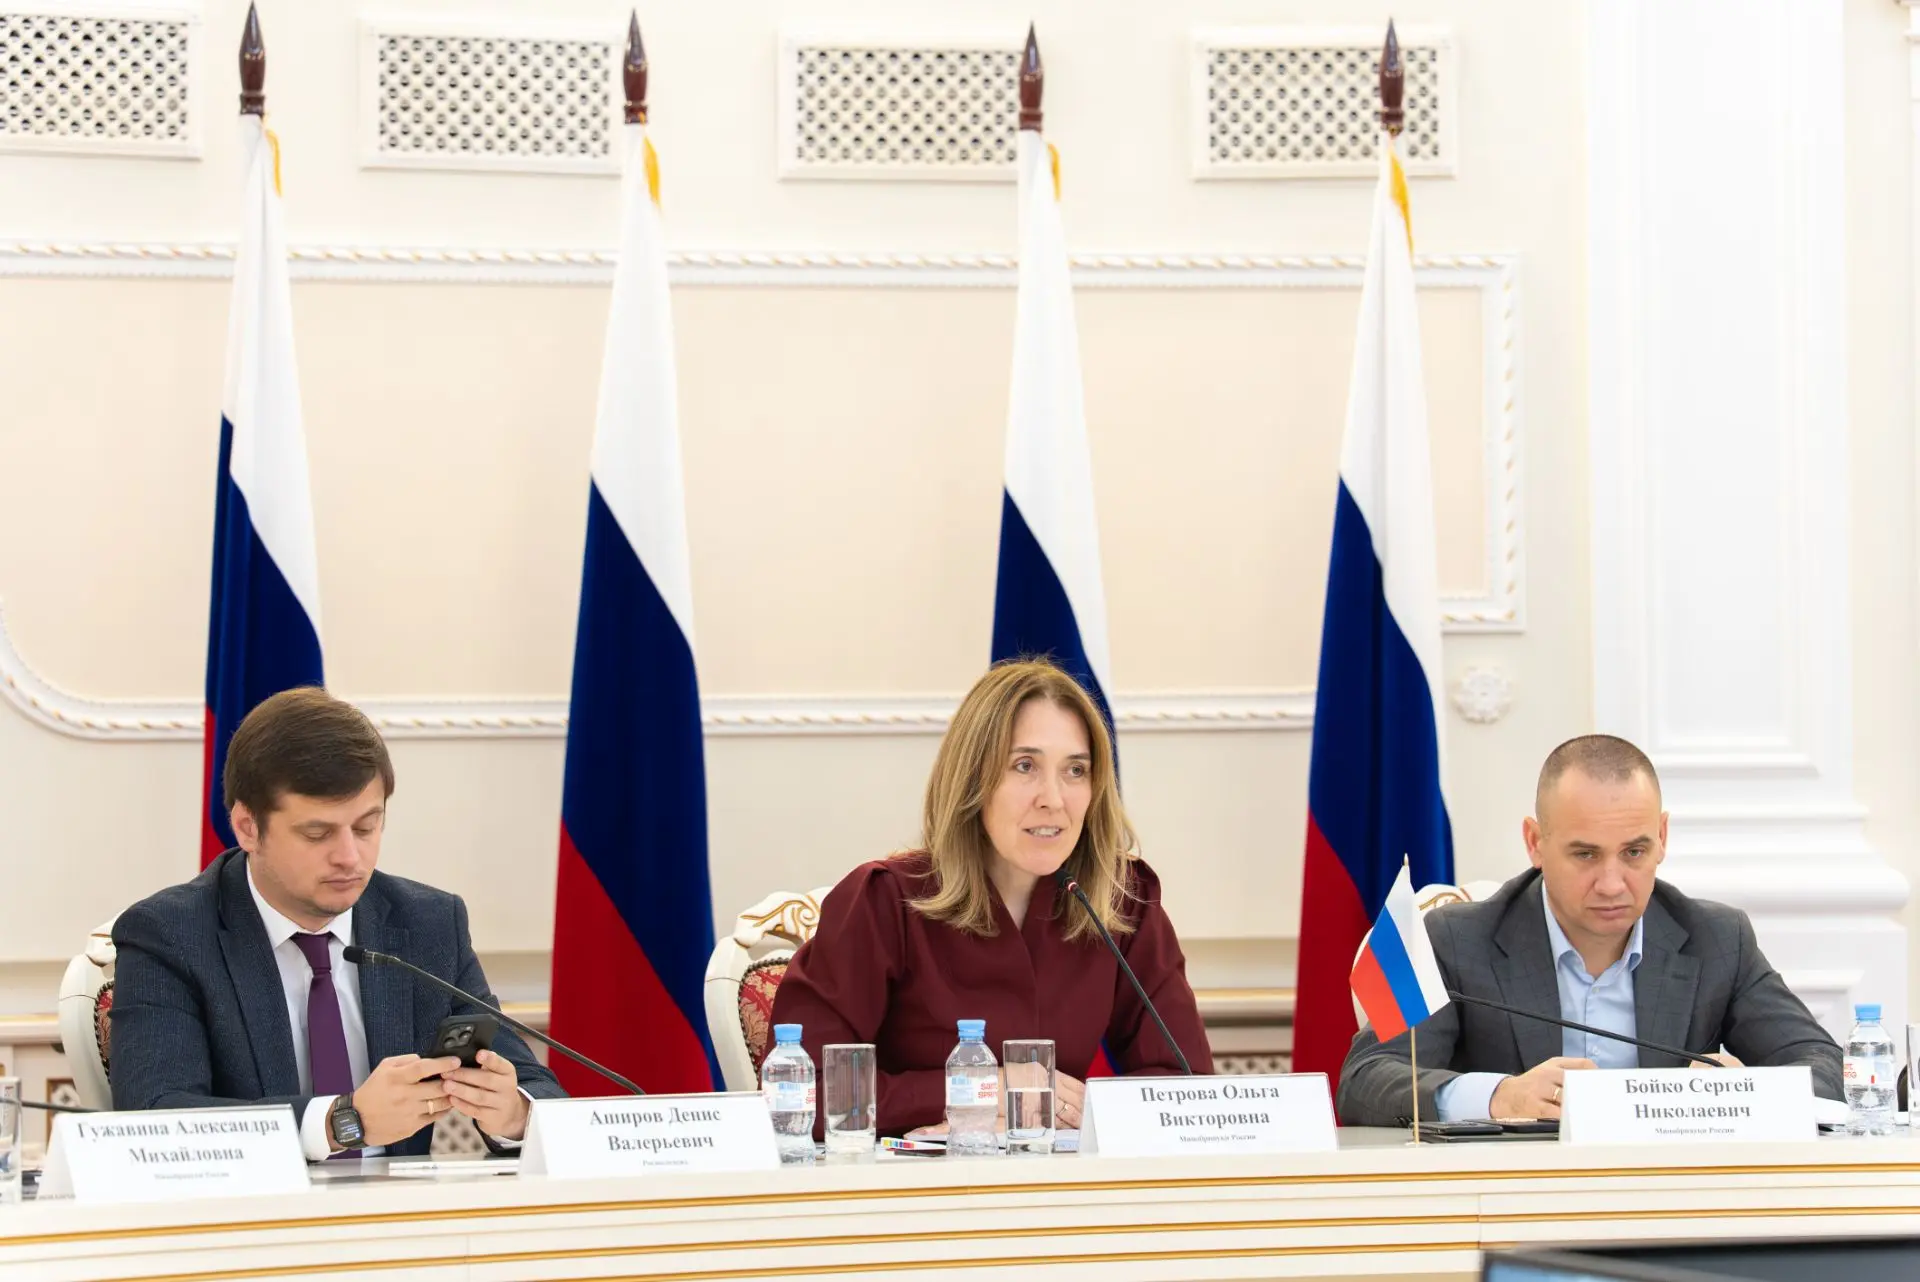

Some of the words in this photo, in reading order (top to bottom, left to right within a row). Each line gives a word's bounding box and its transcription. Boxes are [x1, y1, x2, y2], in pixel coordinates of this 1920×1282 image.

[1140, 1085, 1218, 1104] Петрова
[1222, 1084, 1280, 1100] Ольга
[1625, 1078, 1684, 1094] Бойко
[1688, 1077, 1755, 1096] Сергей
[589, 1108, 664, 1128] Аширов
[668, 1107, 722, 1124] Денис
[1159, 1111, 1271, 1129] Викторовна
[1634, 1103, 1751, 1119] Николаевич
[77, 1121, 170, 1142] Гужавина
[174, 1117, 281, 1137] Александра
[607, 1133, 714, 1153] Валерьевич
[129, 1147, 244, 1164] Михайловна
